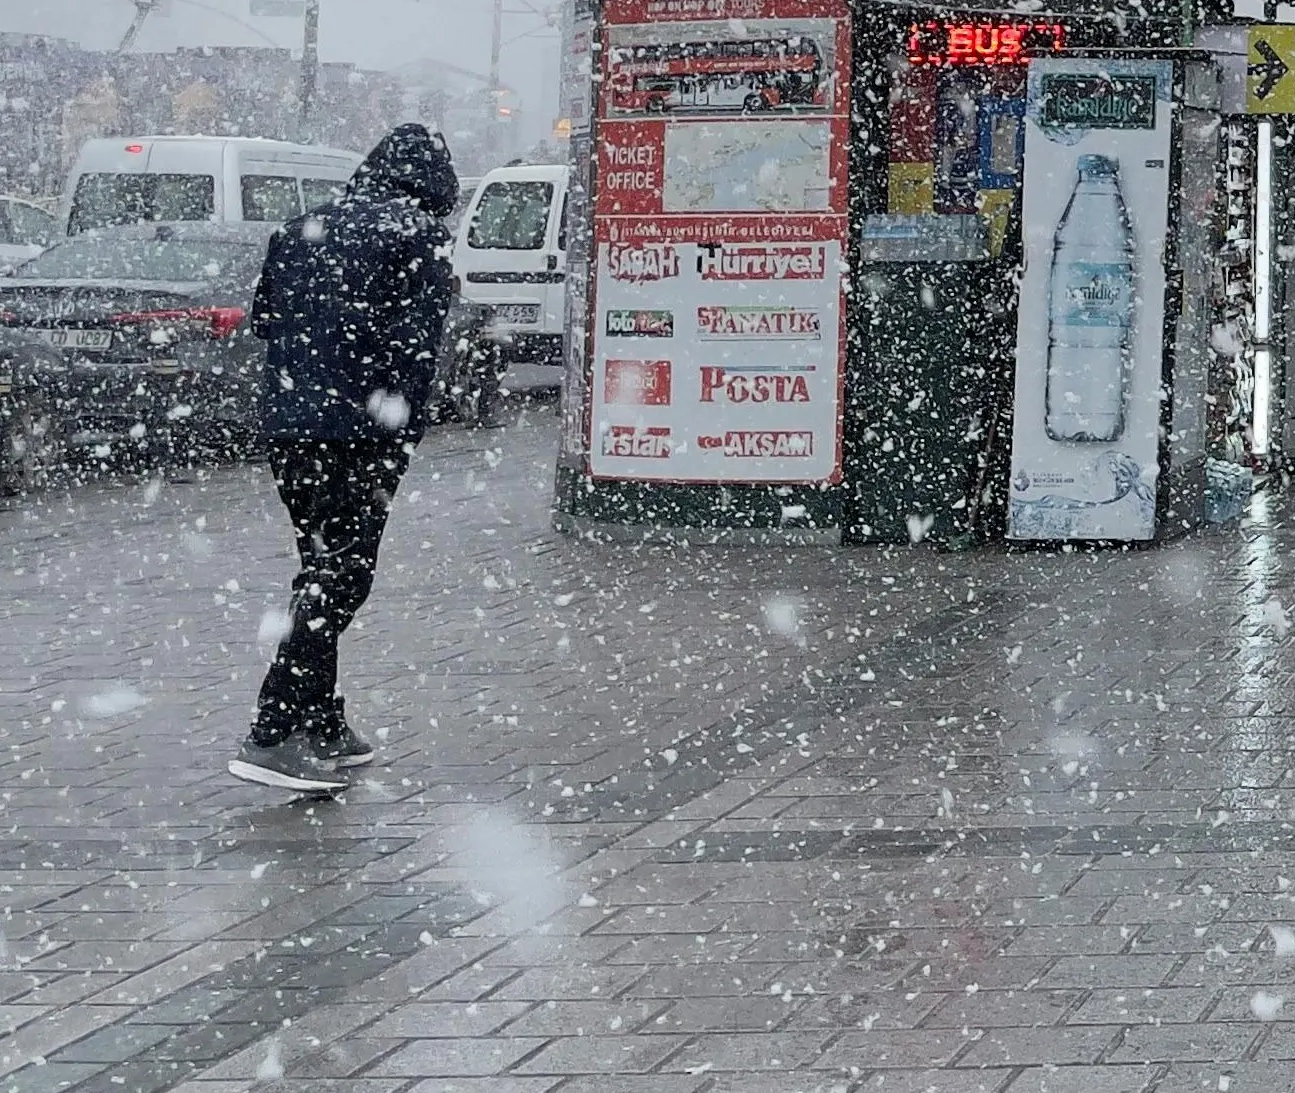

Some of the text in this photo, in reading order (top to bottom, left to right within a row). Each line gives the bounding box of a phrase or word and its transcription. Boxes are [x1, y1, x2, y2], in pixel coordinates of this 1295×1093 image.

[948, 27, 1023, 54] BUS
[609, 144, 656, 166] TICKET
[606, 171, 655, 191] OFFICE
[610, 245, 675, 277] SABAH
[701, 246, 823, 279] Hürriyet
[699, 366, 810, 403] POSTA
